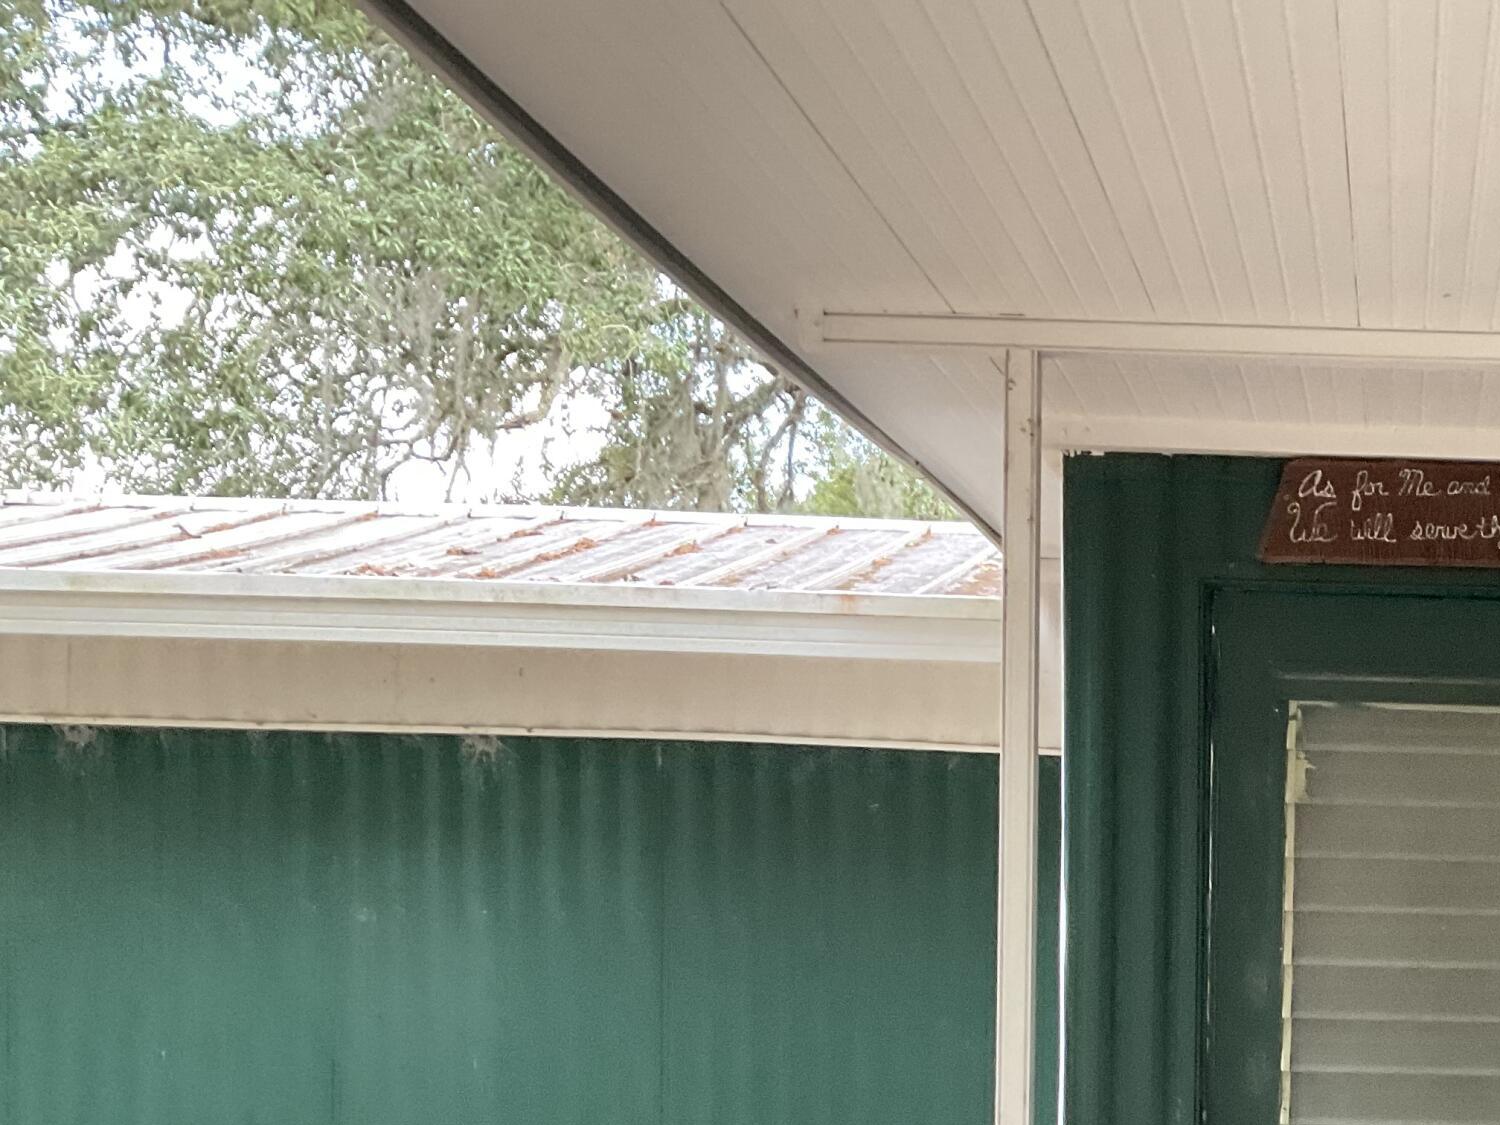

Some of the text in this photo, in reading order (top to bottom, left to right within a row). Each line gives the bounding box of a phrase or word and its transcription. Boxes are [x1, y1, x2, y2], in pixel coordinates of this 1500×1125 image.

[1298, 469, 1336, 498] As
[1351, 470, 1389, 511] for
[1447, 475, 1491, 495] and
[1287, 502, 1338, 543] We
[1350, 512, 1396, 542] will
[1410, 520, 1477, 540] serve
